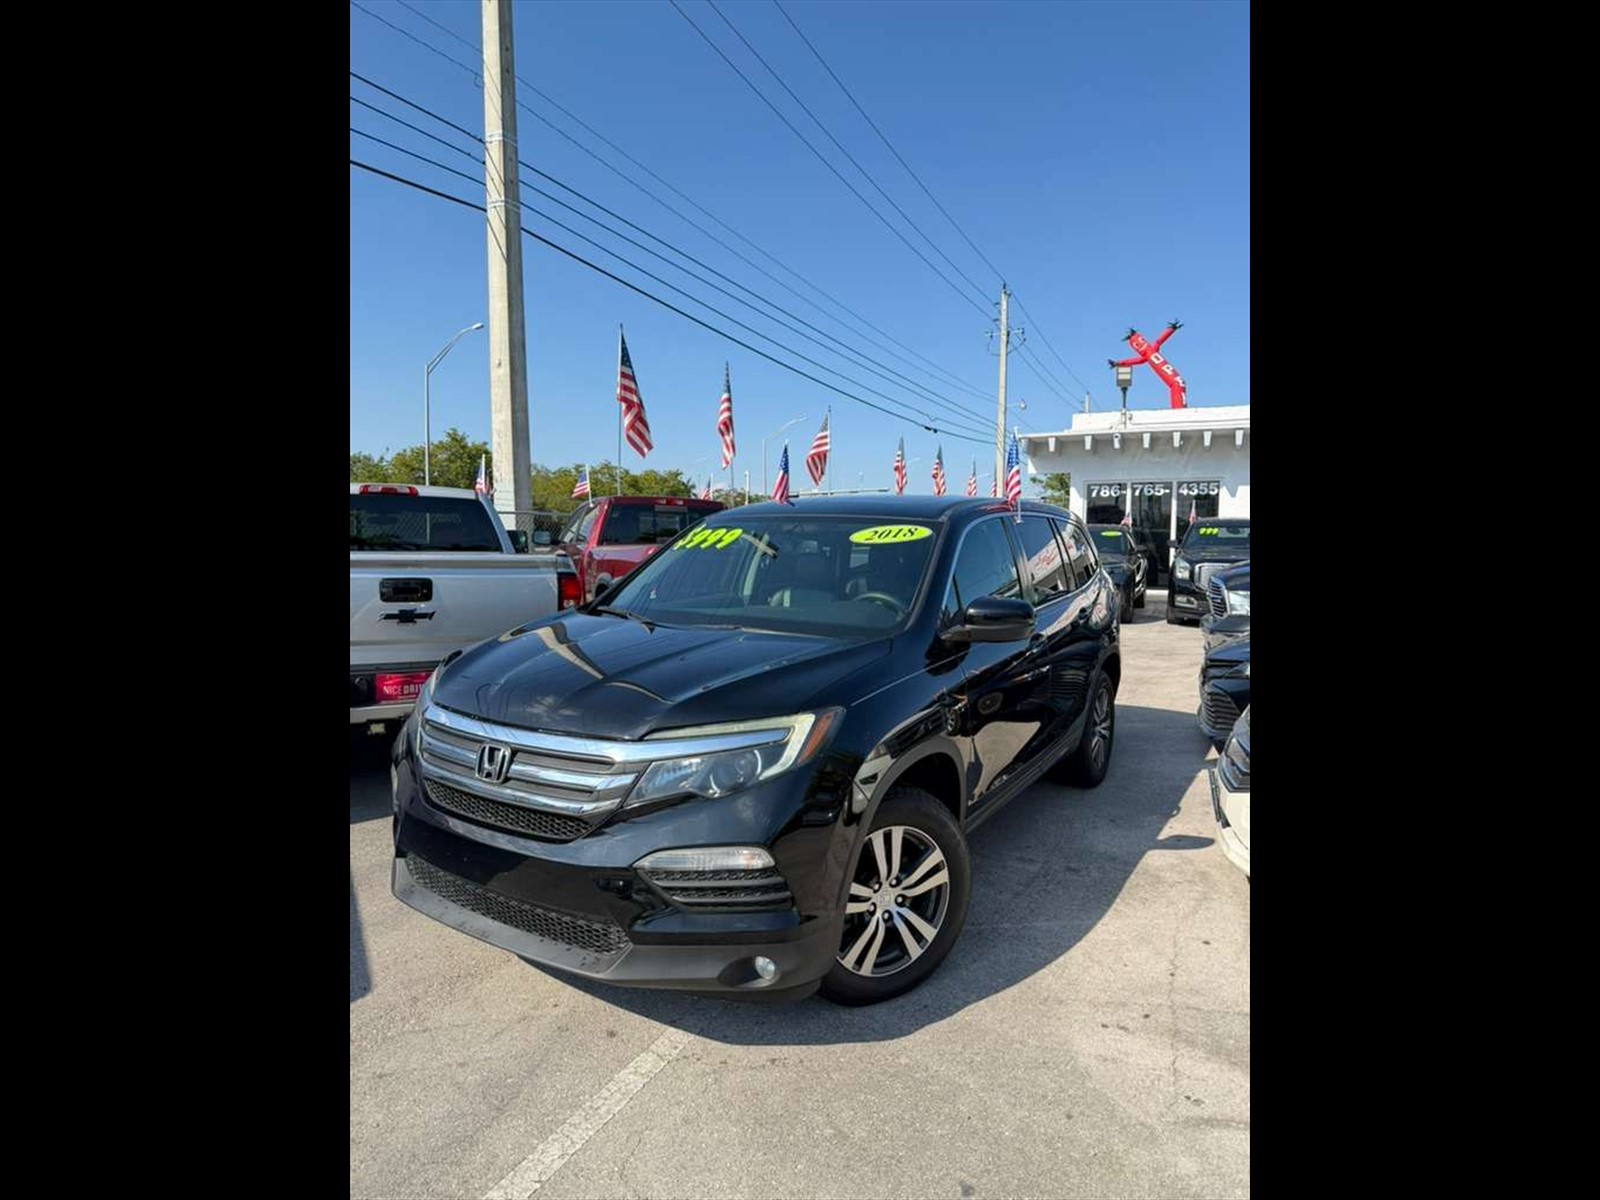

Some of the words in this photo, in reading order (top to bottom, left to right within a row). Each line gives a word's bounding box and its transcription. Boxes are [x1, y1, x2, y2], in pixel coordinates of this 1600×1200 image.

[1090, 485, 1127, 498] 786-
[1133, 484, 1170, 496] 765-
[1179, 482, 1219, 496] 4355
[863, 527, 919, 541] 2018
[383, 685, 402, 695] NICE
